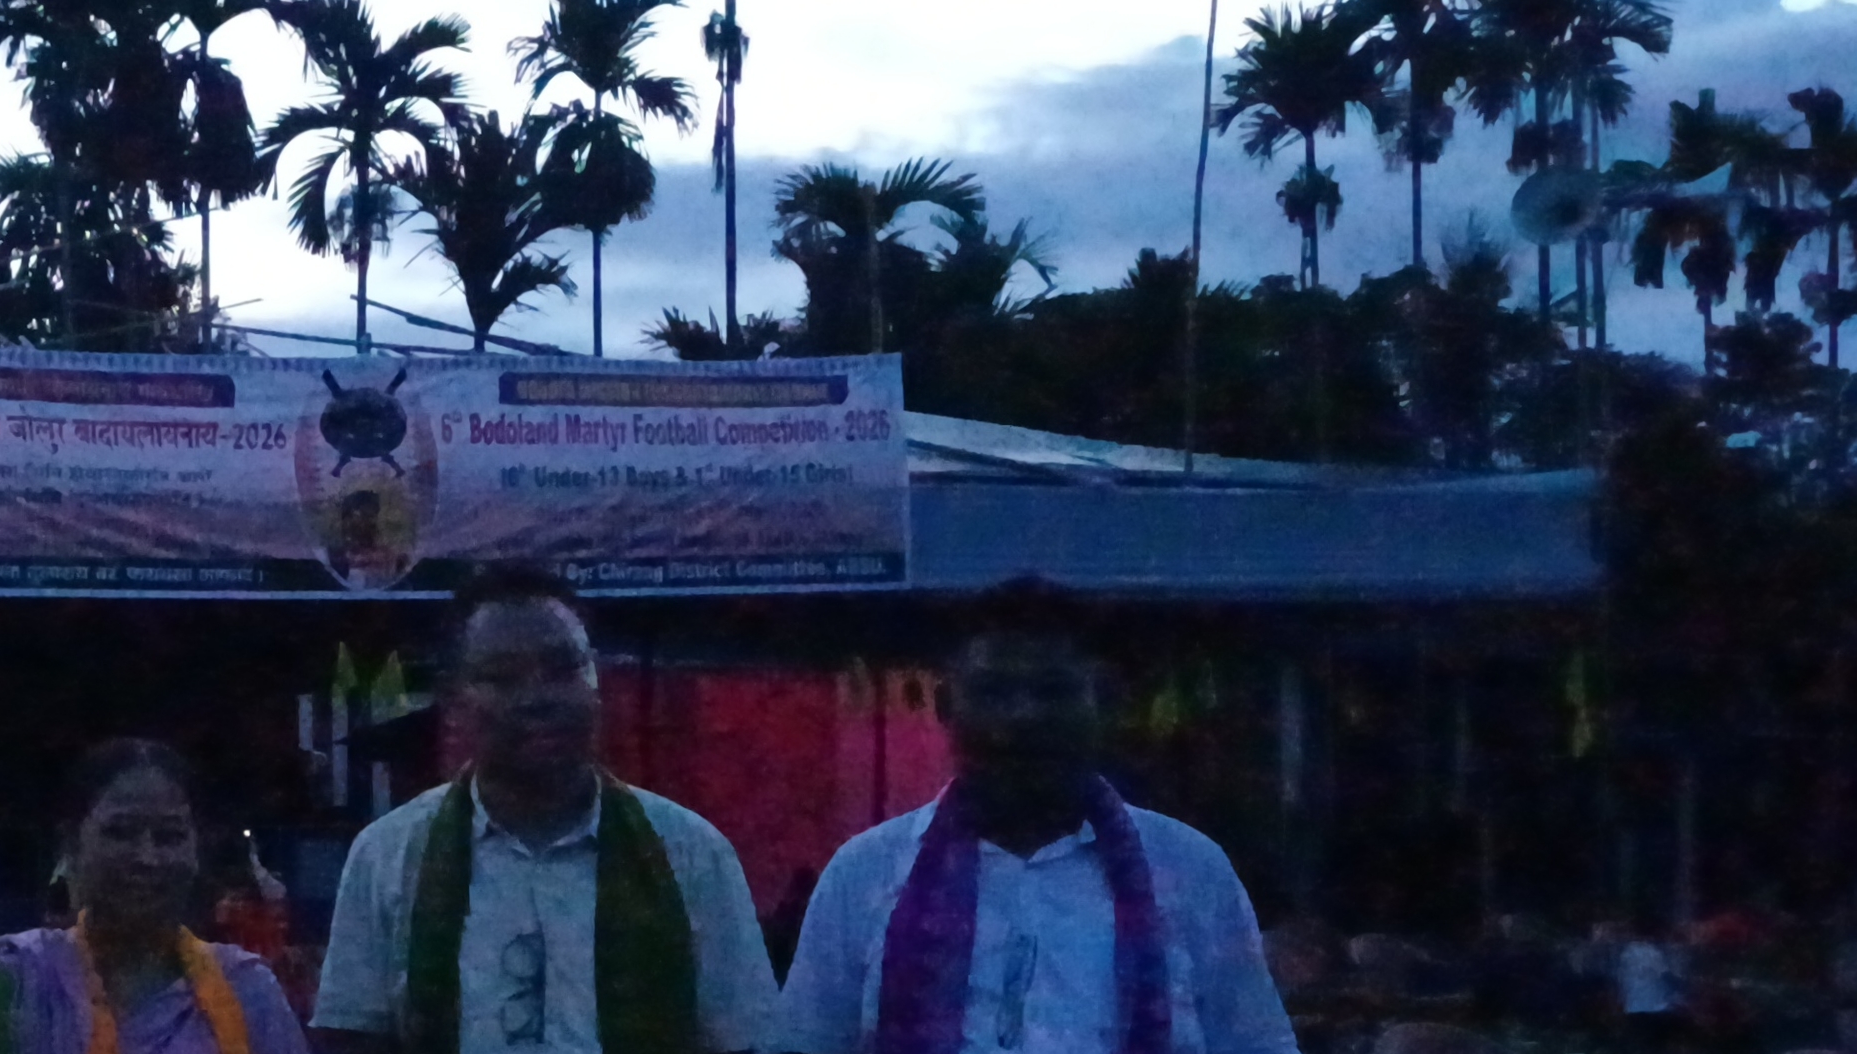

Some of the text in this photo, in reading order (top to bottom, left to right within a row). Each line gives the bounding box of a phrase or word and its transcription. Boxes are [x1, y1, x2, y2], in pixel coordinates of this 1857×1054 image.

[469, 412, 559, 446] Bodoland
[565, 413, 627, 452] Martyr
[632, 413, 709, 446] Football
[714, 413, 829, 446] Competition
[843, 408, 891, 442] 2026
